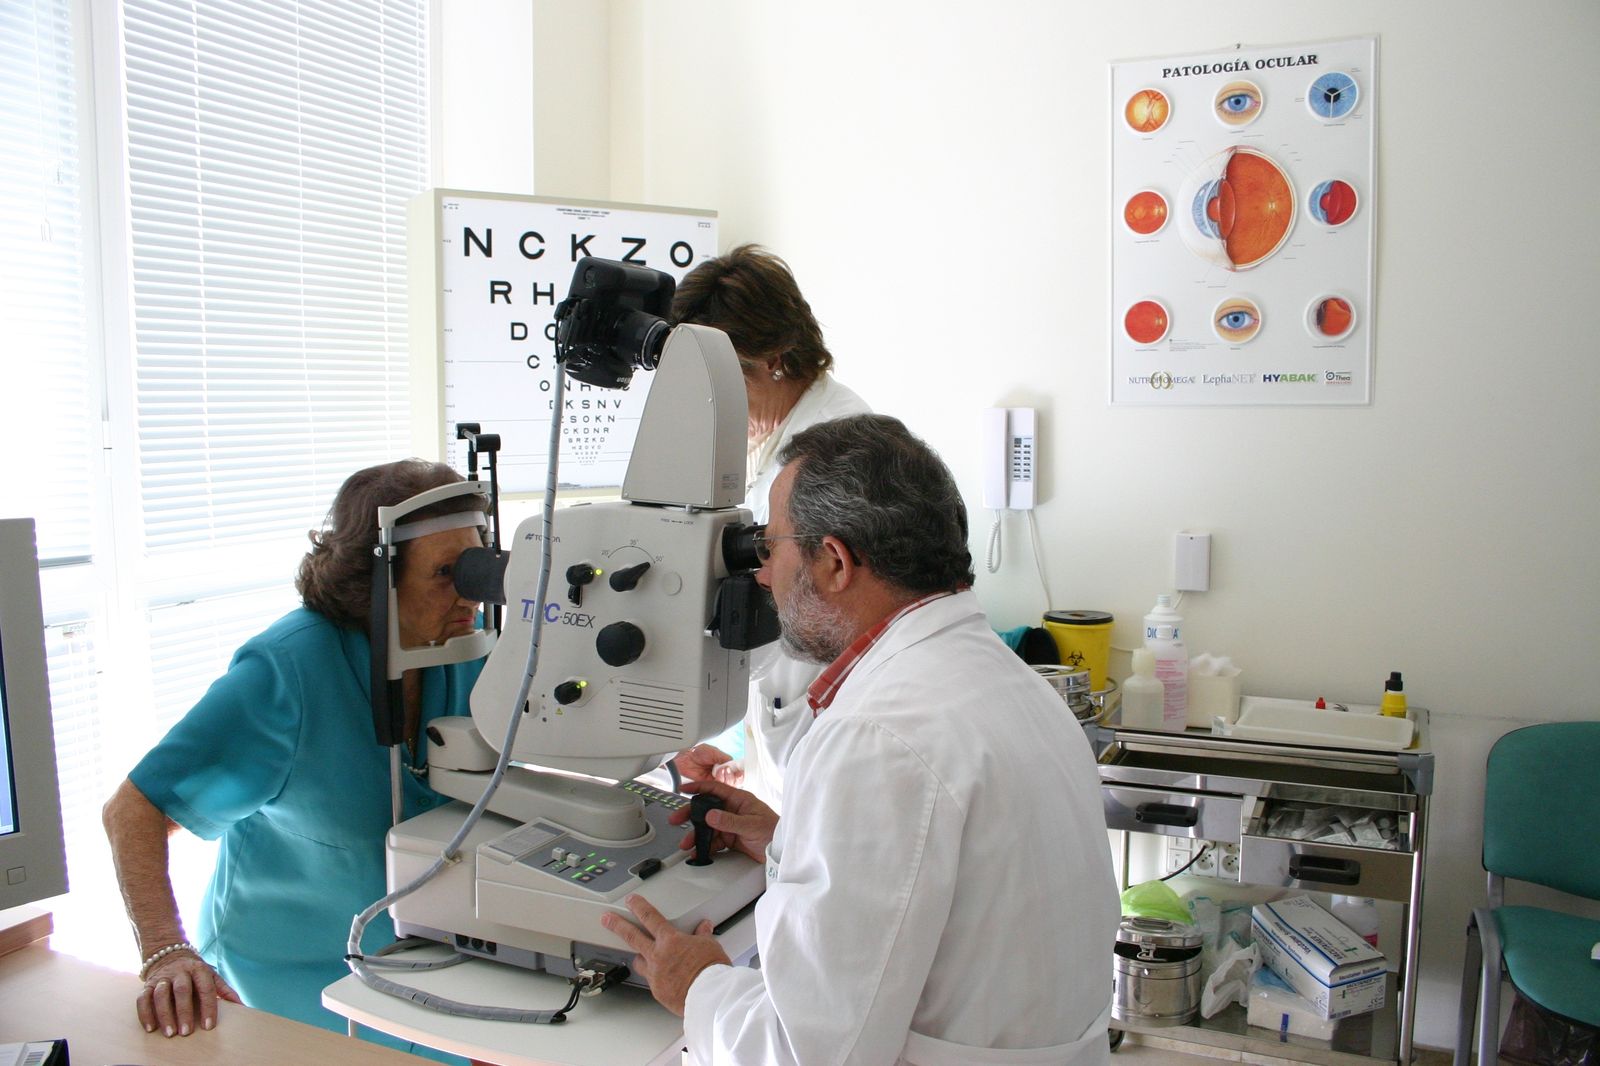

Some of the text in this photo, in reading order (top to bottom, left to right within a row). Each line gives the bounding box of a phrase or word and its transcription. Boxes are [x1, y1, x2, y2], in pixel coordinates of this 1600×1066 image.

[1162, 54, 1319, 79] PATOLOGÍA OCULAR
[1263, 374, 1316, 383] HYABAK
